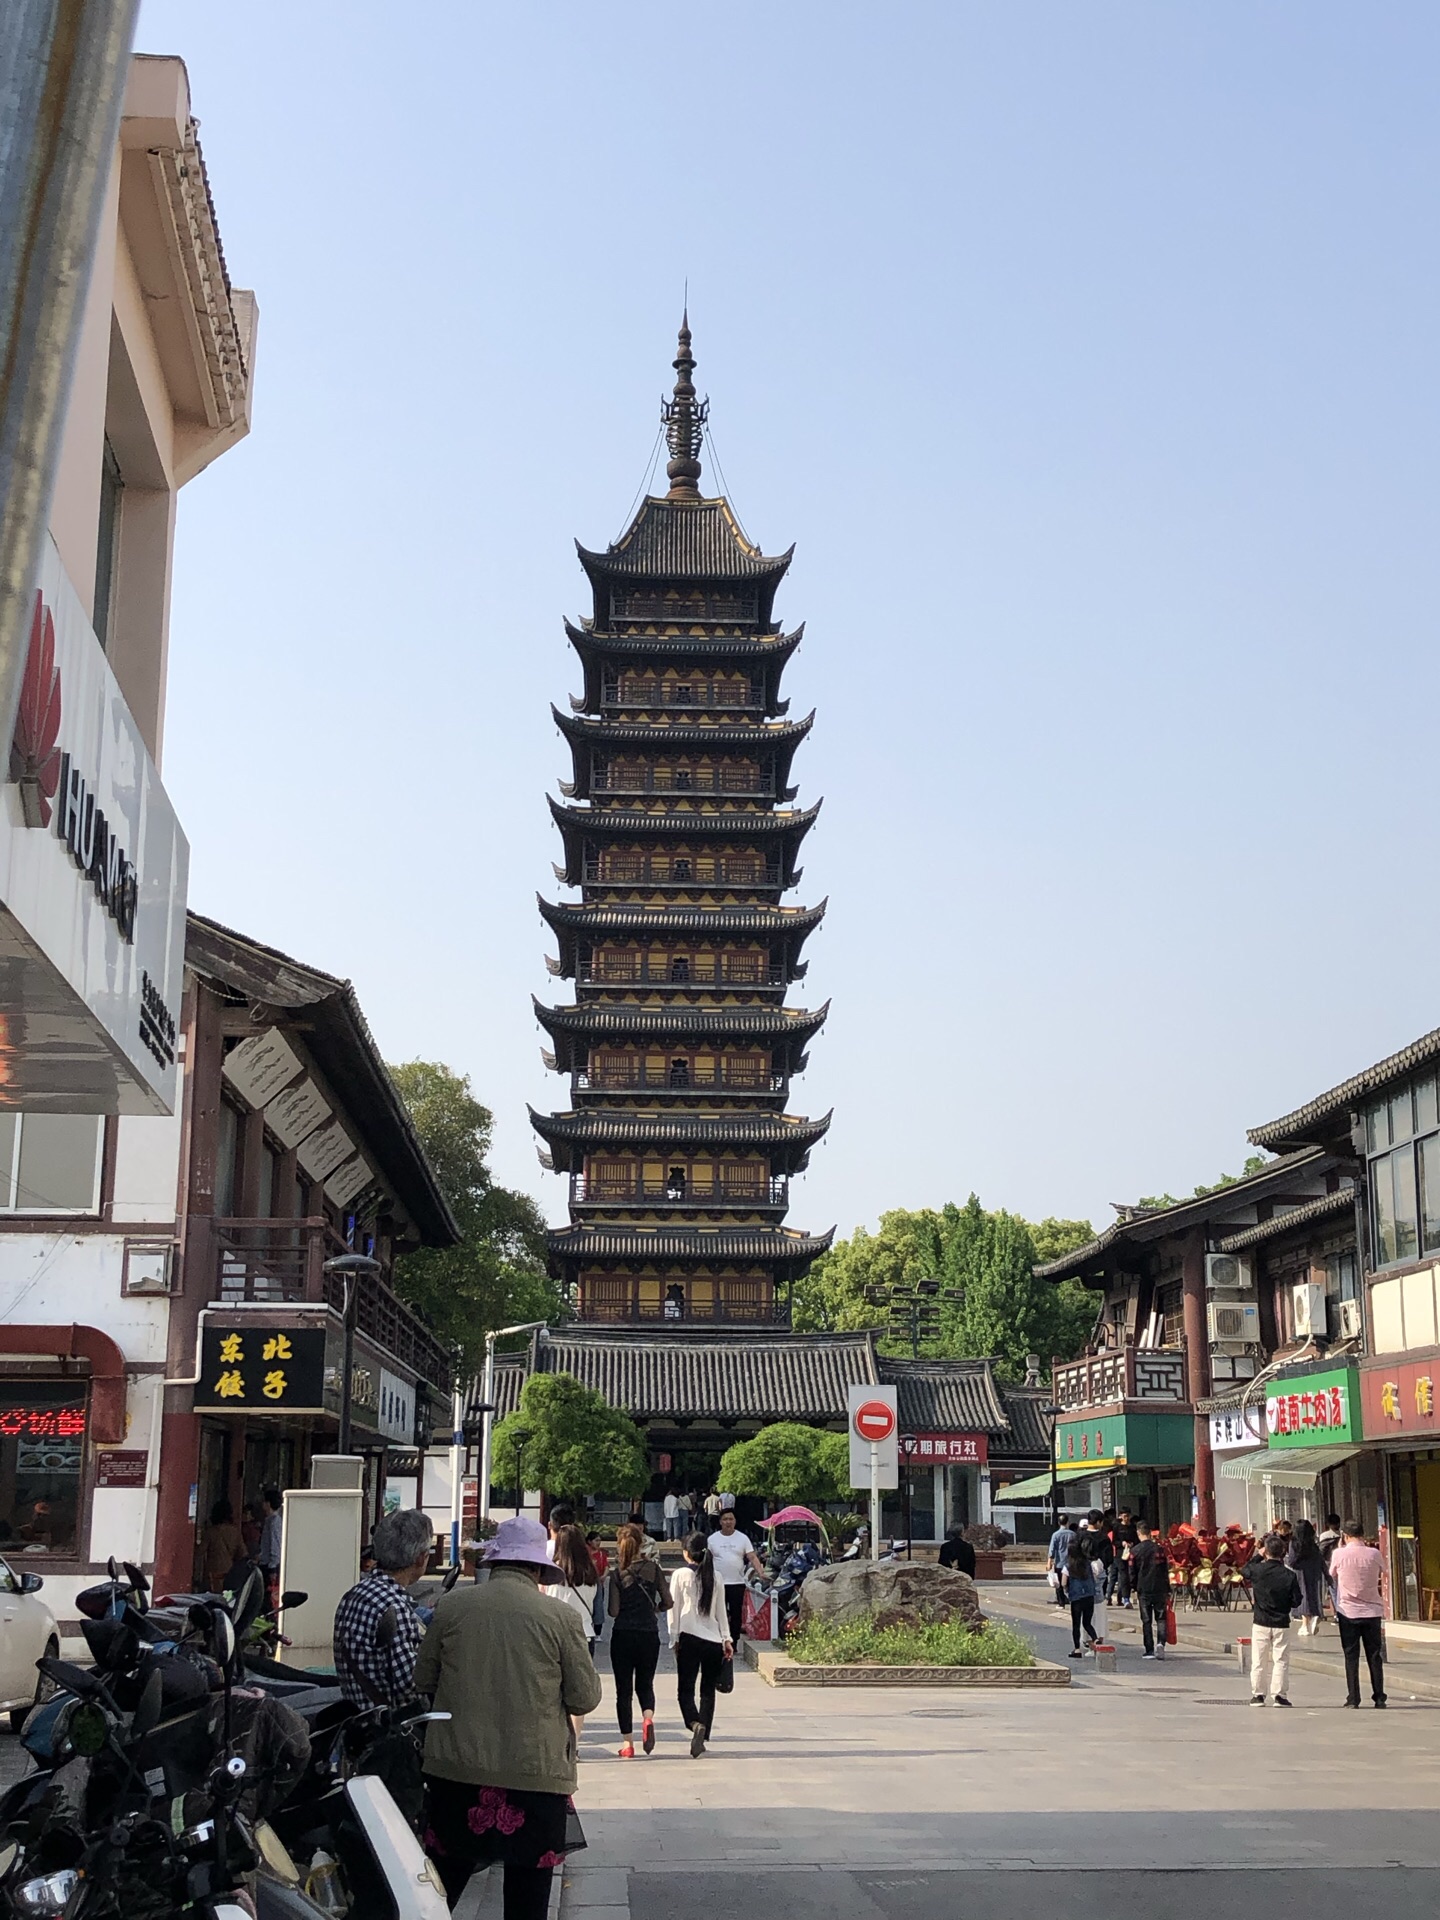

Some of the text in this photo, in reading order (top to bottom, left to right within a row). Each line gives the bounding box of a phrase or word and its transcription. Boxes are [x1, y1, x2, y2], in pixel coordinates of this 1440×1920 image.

[220, 1333, 293, 1363] 东北
[214, 1370, 288, 1399] 饺子
[1276, 1386, 1344, 1434] 淮南牛肉汤
